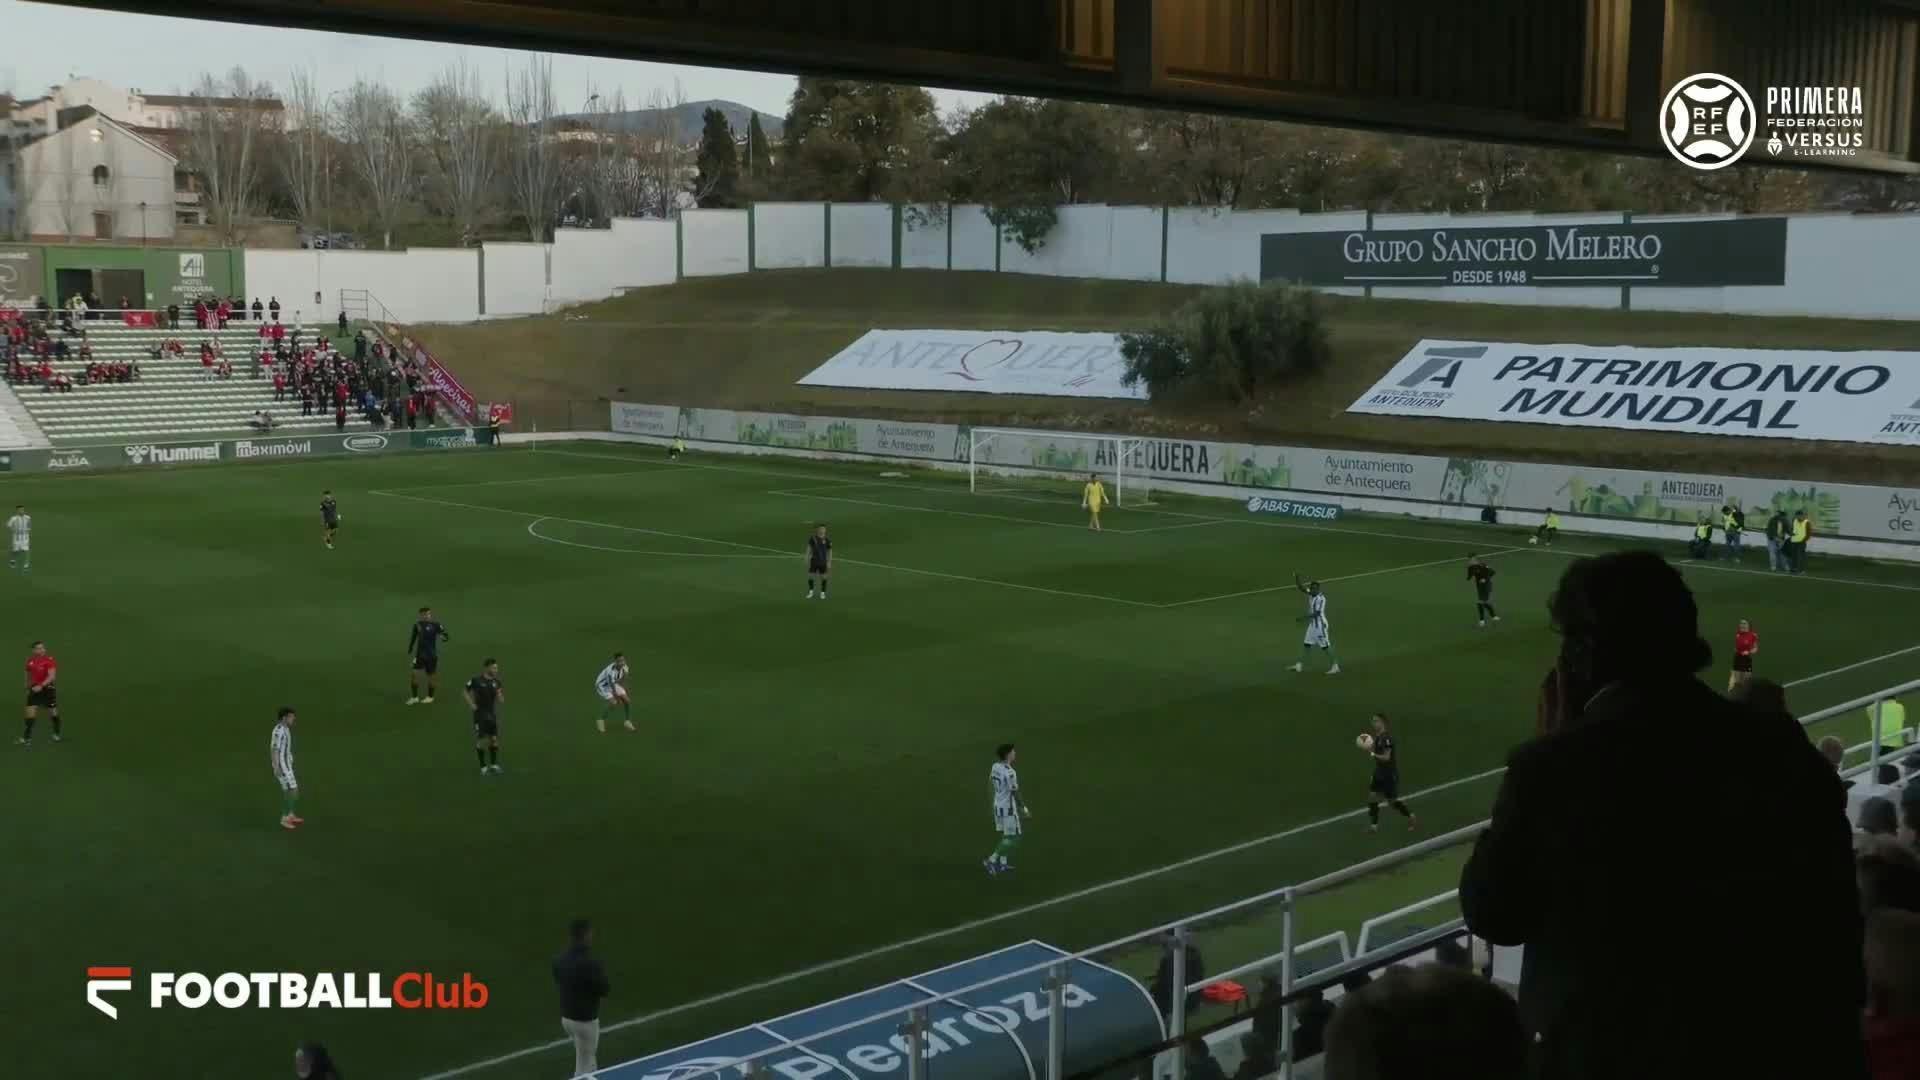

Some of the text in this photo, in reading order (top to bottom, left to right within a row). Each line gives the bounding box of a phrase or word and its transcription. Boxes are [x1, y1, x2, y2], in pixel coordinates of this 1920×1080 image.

[1343, 228, 1662, 263] GRUPO SANCHO MELERO
[1453, 270, 1526, 284] DESDE 1948
[1493, 354, 1891, 395] PATRIMONIO
[1367, 394, 1446, 409] ANTEQUERA
[1497, 387, 1801, 430] MUNDIAL
[876, 424, 936, 439] Ayuntamiento
[1879, 421, 1920, 433] ANT
[150, 442, 221, 463] hummel
[236, 440, 311, 458] maximóvil
[878, 439, 935, 453] de Antequera
[1095, 440, 1209, 475] ANTEQUERA
[1325, 455, 1414, 474] Ayuntamiento
[1325, 472, 1411, 491] de Antequera
[1661, 480, 1724, 498] ANTEQUERA
[1261, 500, 1337, 519] ABAS THOSUR
[1888, 516, 1913, 532] de
